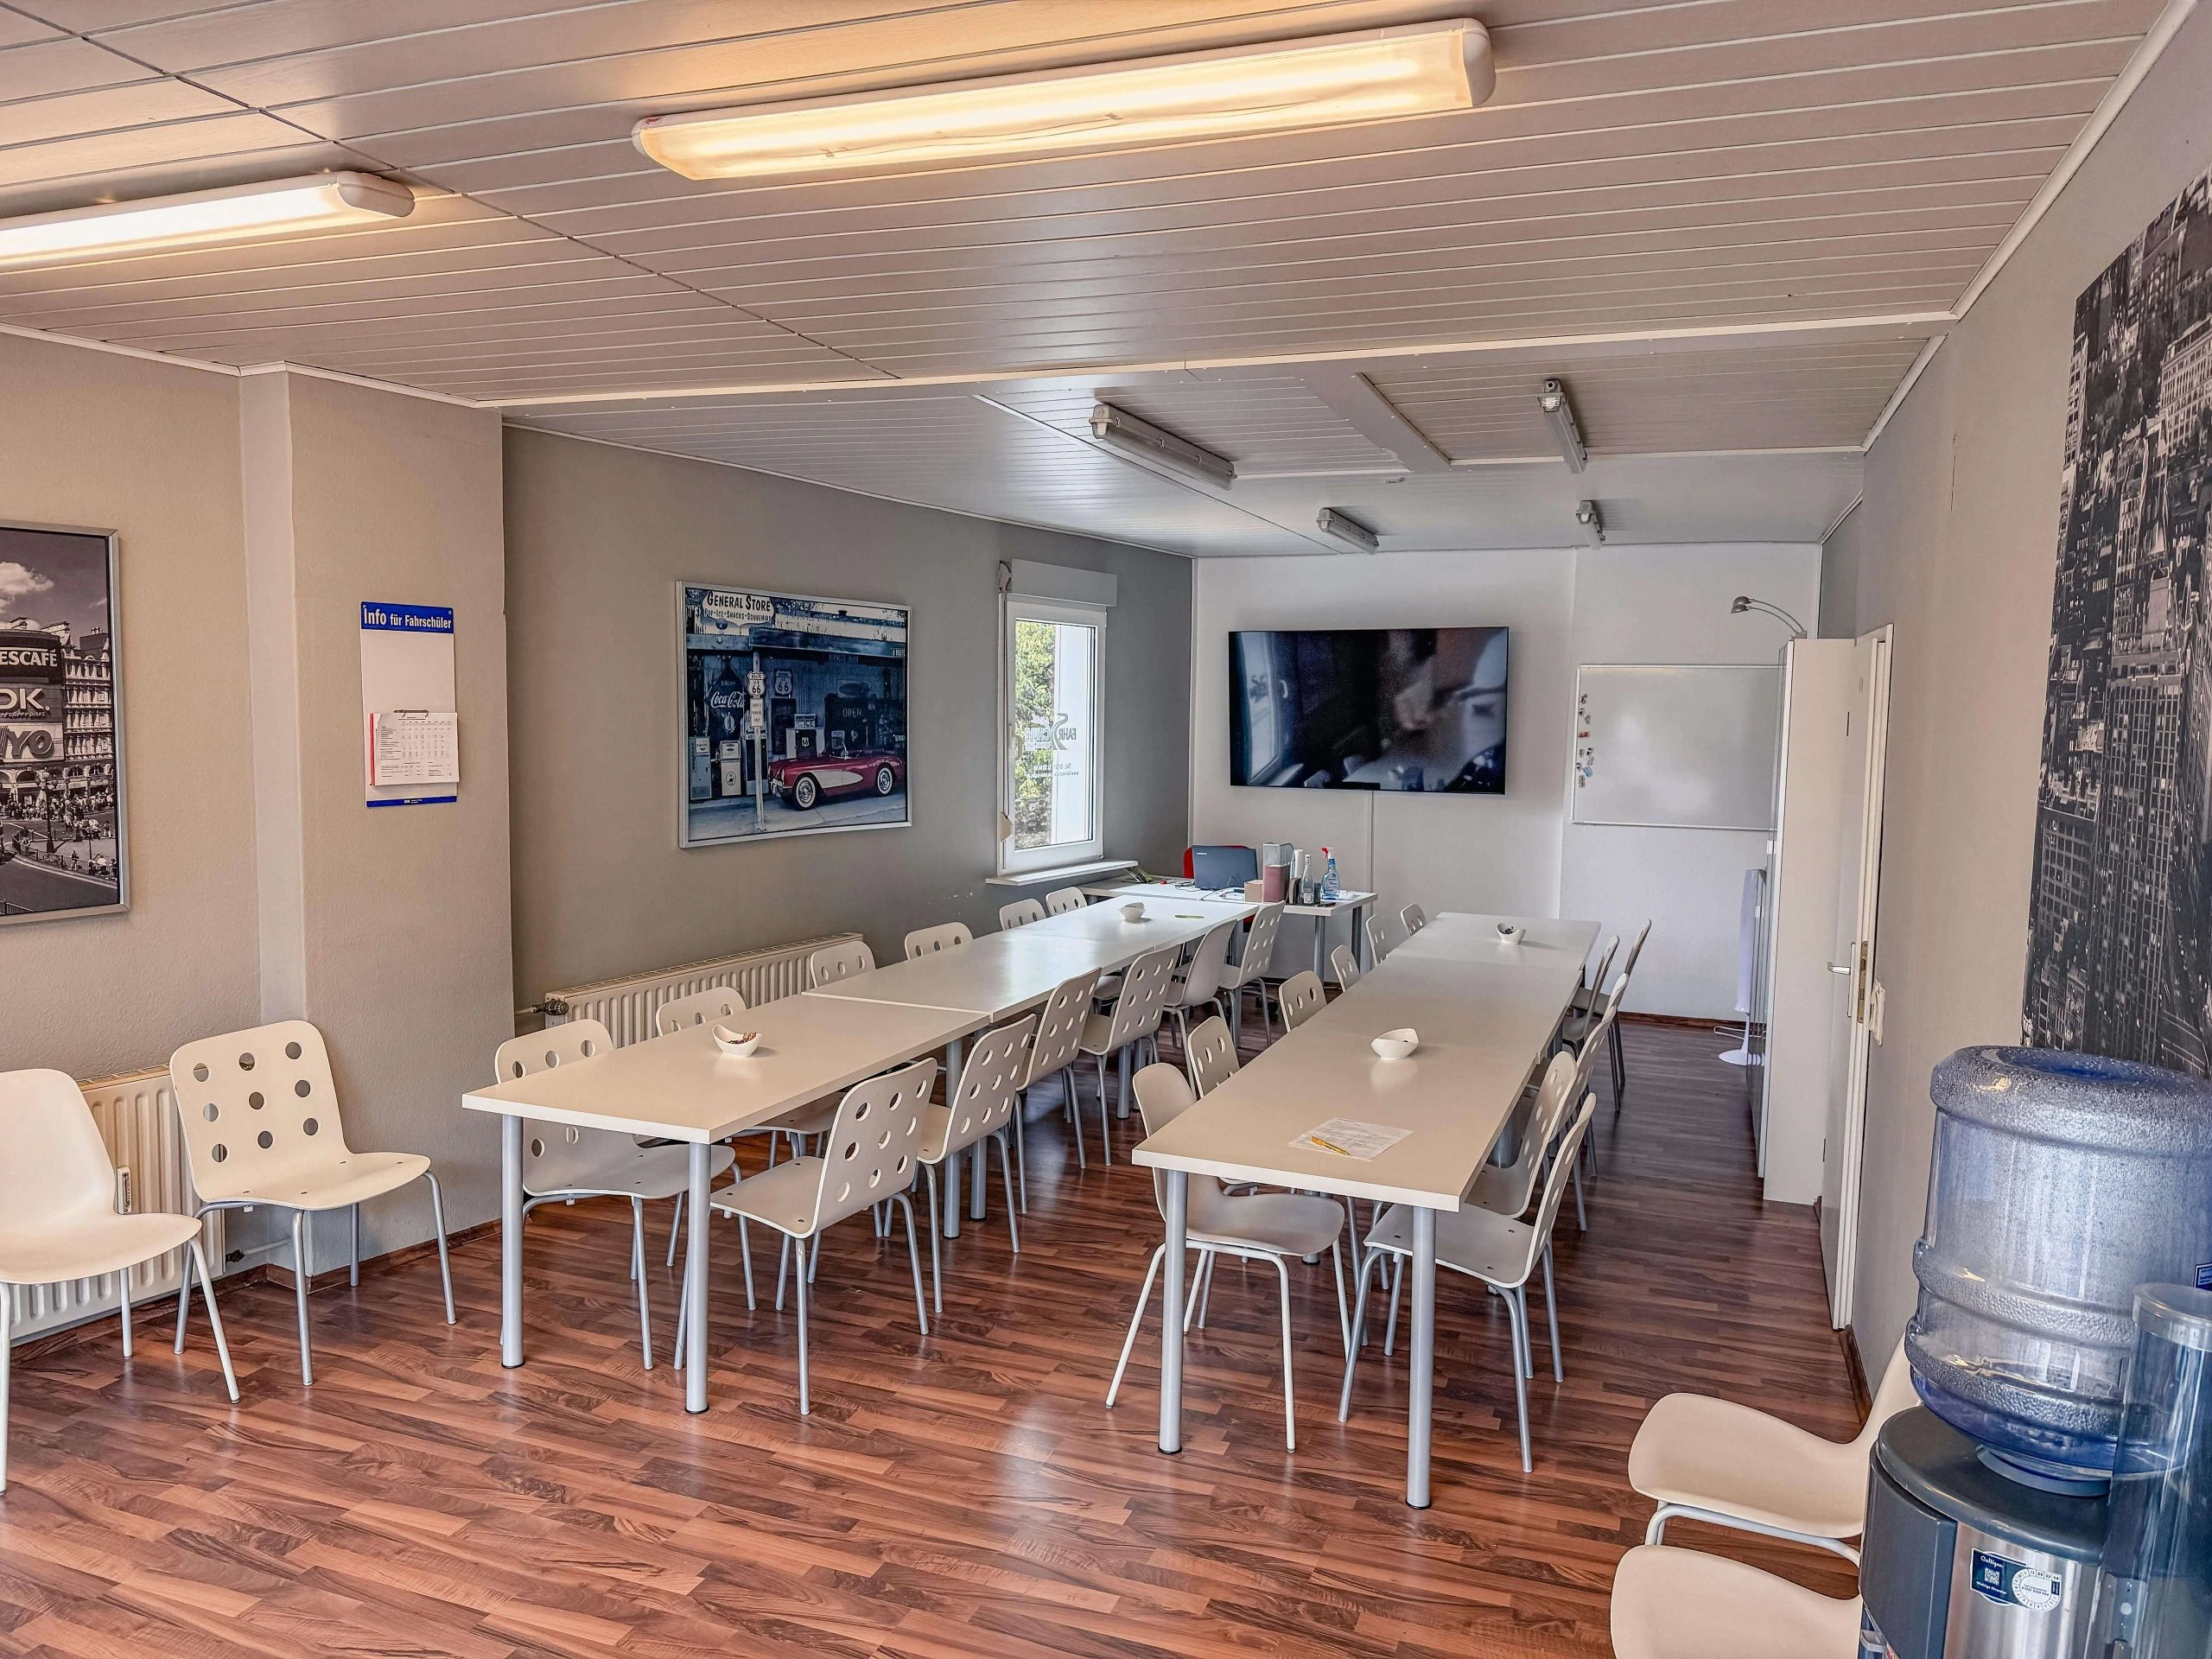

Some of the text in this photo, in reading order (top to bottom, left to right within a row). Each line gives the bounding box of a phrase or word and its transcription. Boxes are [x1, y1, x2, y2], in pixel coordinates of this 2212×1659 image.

[708, 591, 771, 611] GENERAL STORE
[364, 607, 452, 628] Info für Fahrschüler
[778, 681, 789, 691] 66
[842, 709, 862, 718] OPEN
